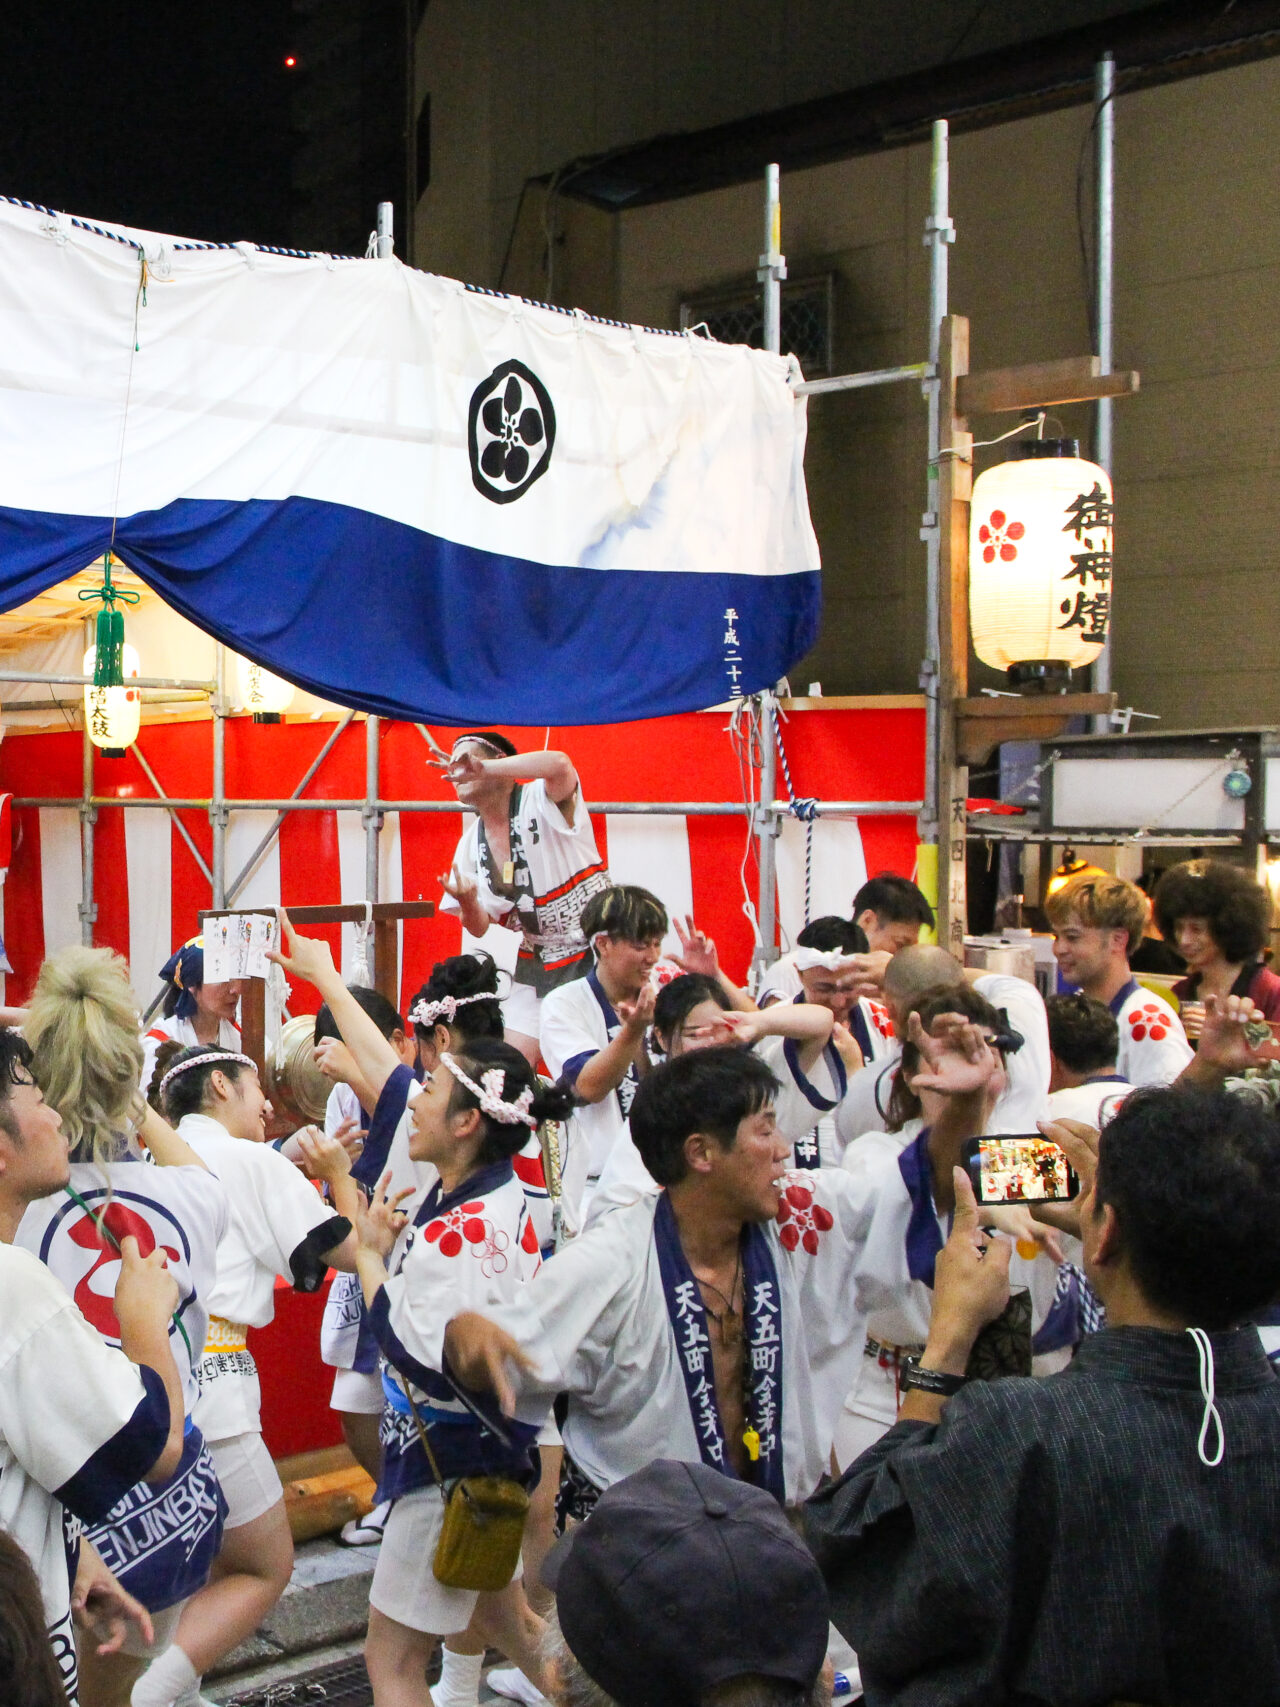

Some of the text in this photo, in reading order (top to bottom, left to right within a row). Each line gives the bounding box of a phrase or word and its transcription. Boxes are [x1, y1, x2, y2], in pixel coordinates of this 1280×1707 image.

[723, 608, 744, 699] 平成二十三
[950, 797, 965, 963] 天四北商
